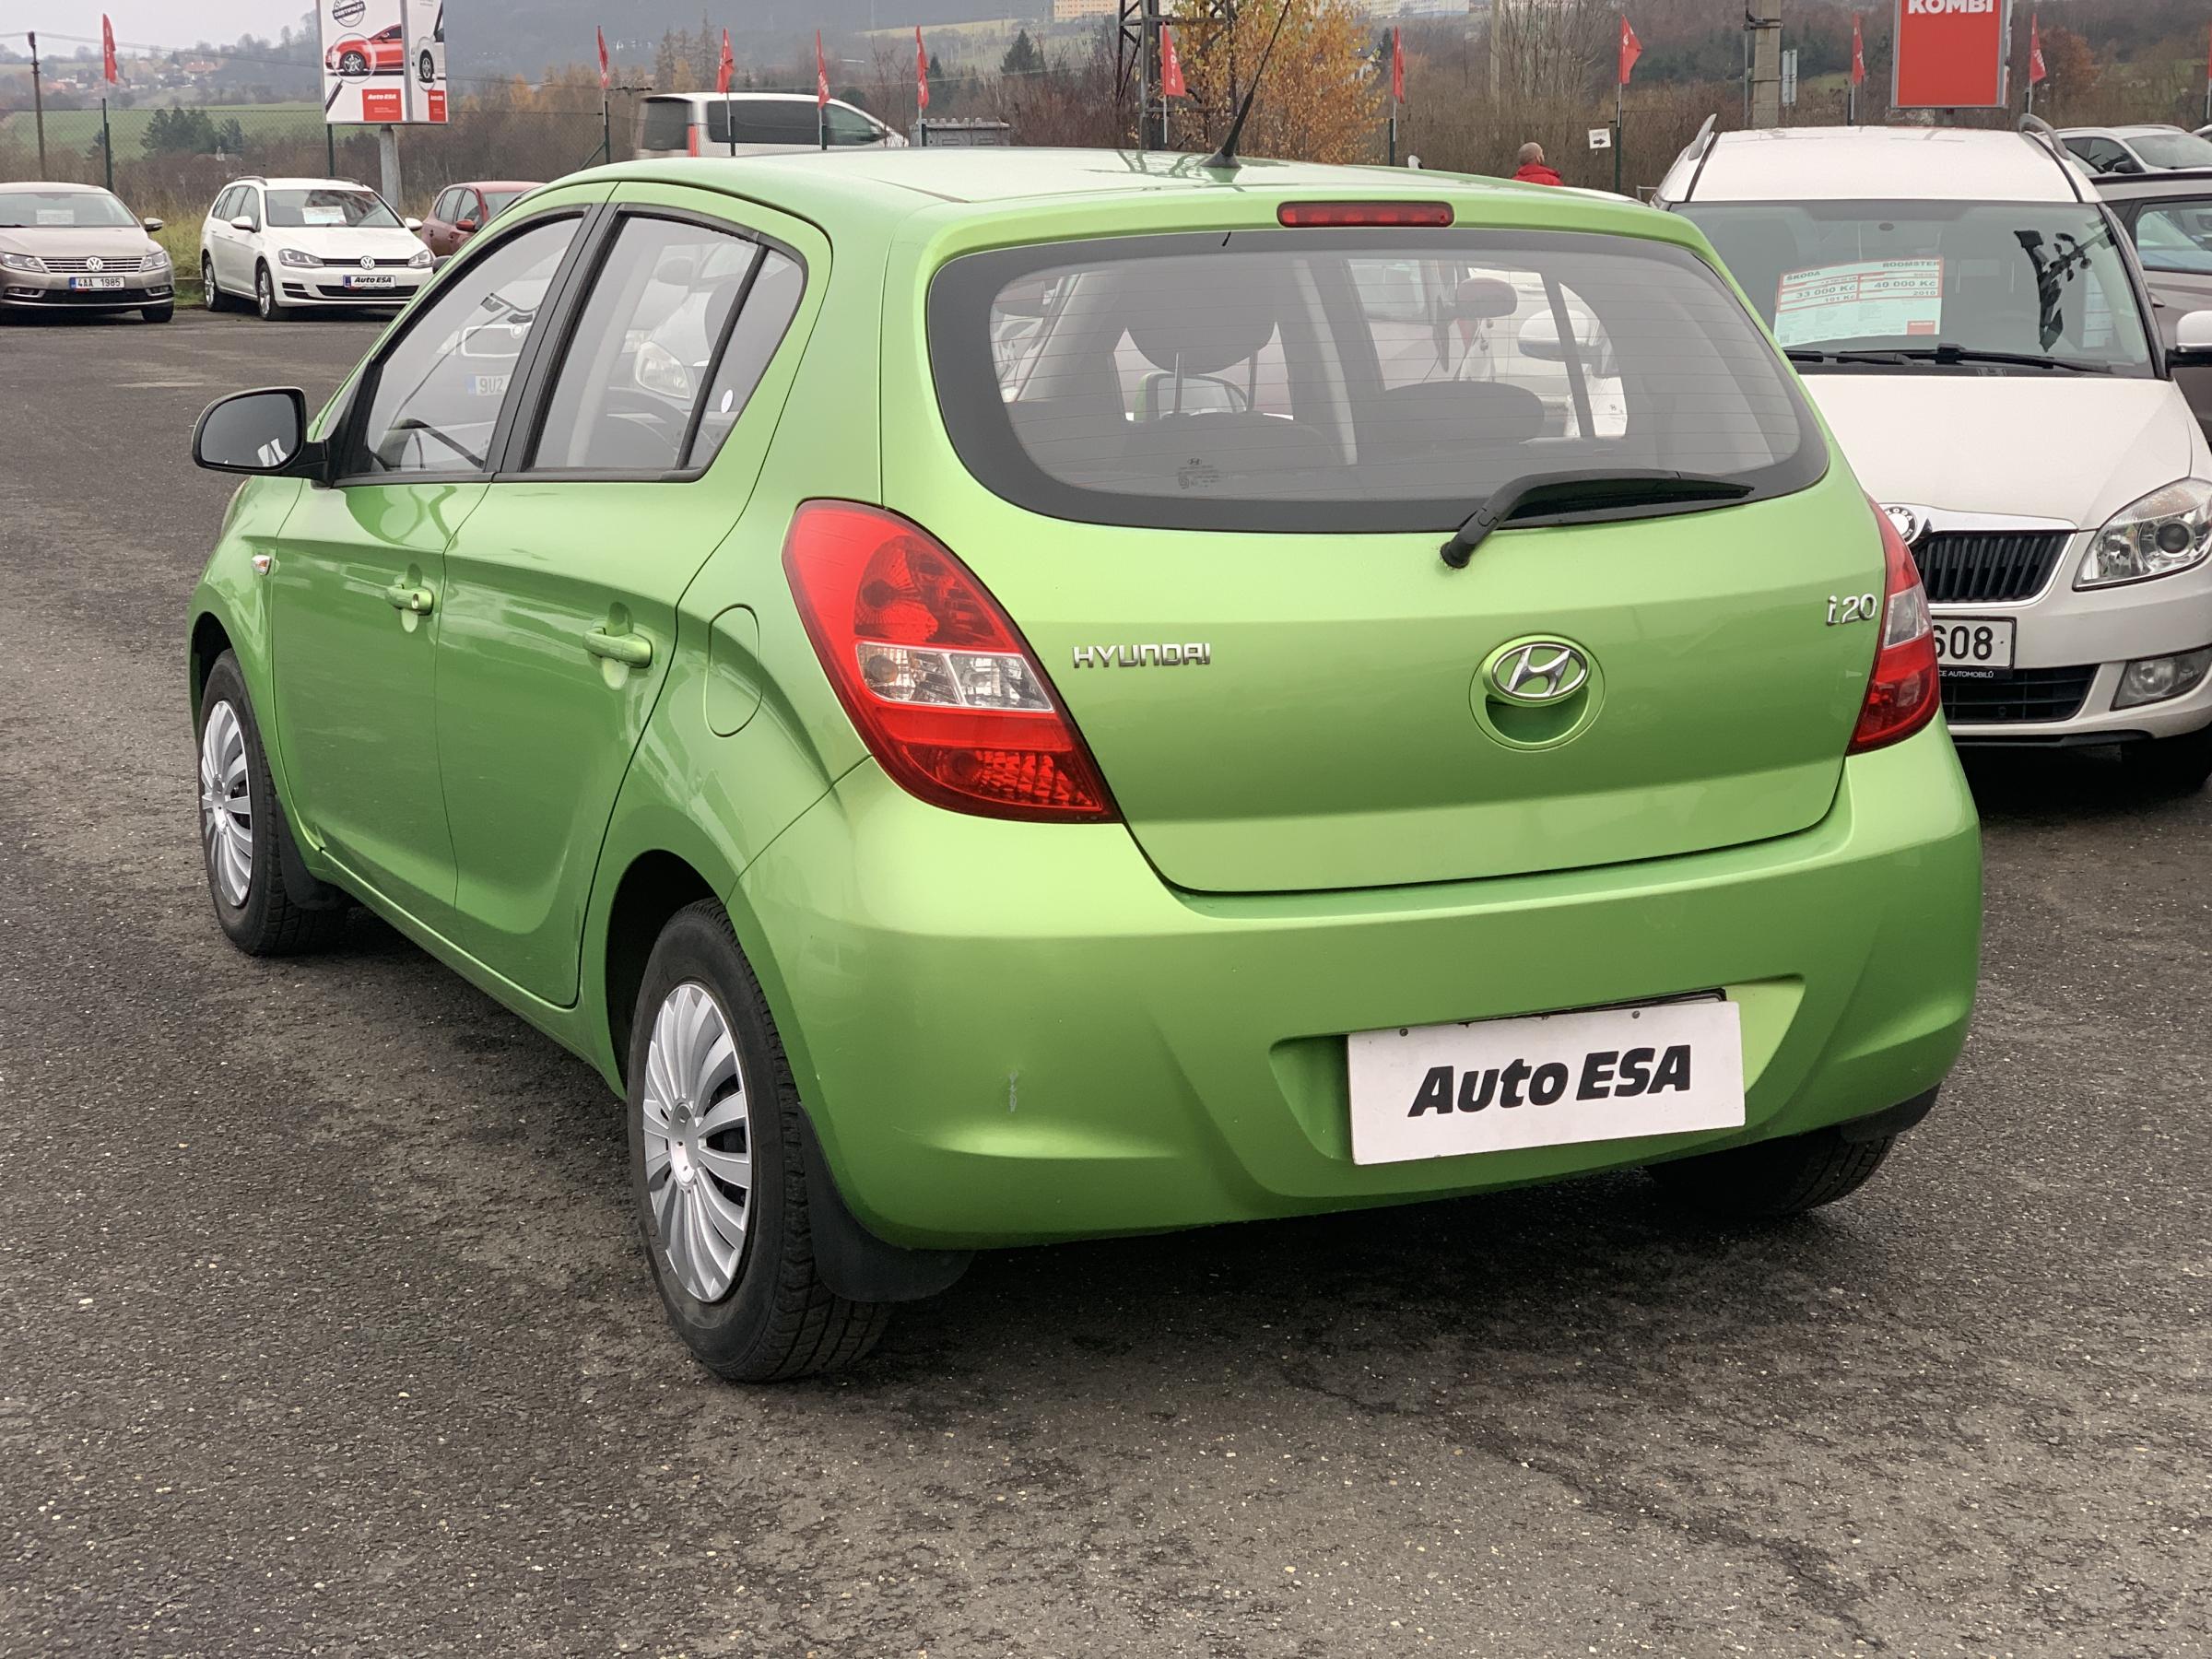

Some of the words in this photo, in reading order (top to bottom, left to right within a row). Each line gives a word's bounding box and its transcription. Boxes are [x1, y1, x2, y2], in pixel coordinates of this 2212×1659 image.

[1908, 0, 1994, 14] KOMBI
[100, 277, 121, 287] 1985
[1814, 287, 1836, 296] 000
[1826, 593, 1877, 626] i20
[1073, 642, 1211, 669] HYUNDAI
[1406, 1057, 1569, 1118] Auto
[1575, 1043, 1692, 1101] ESA
